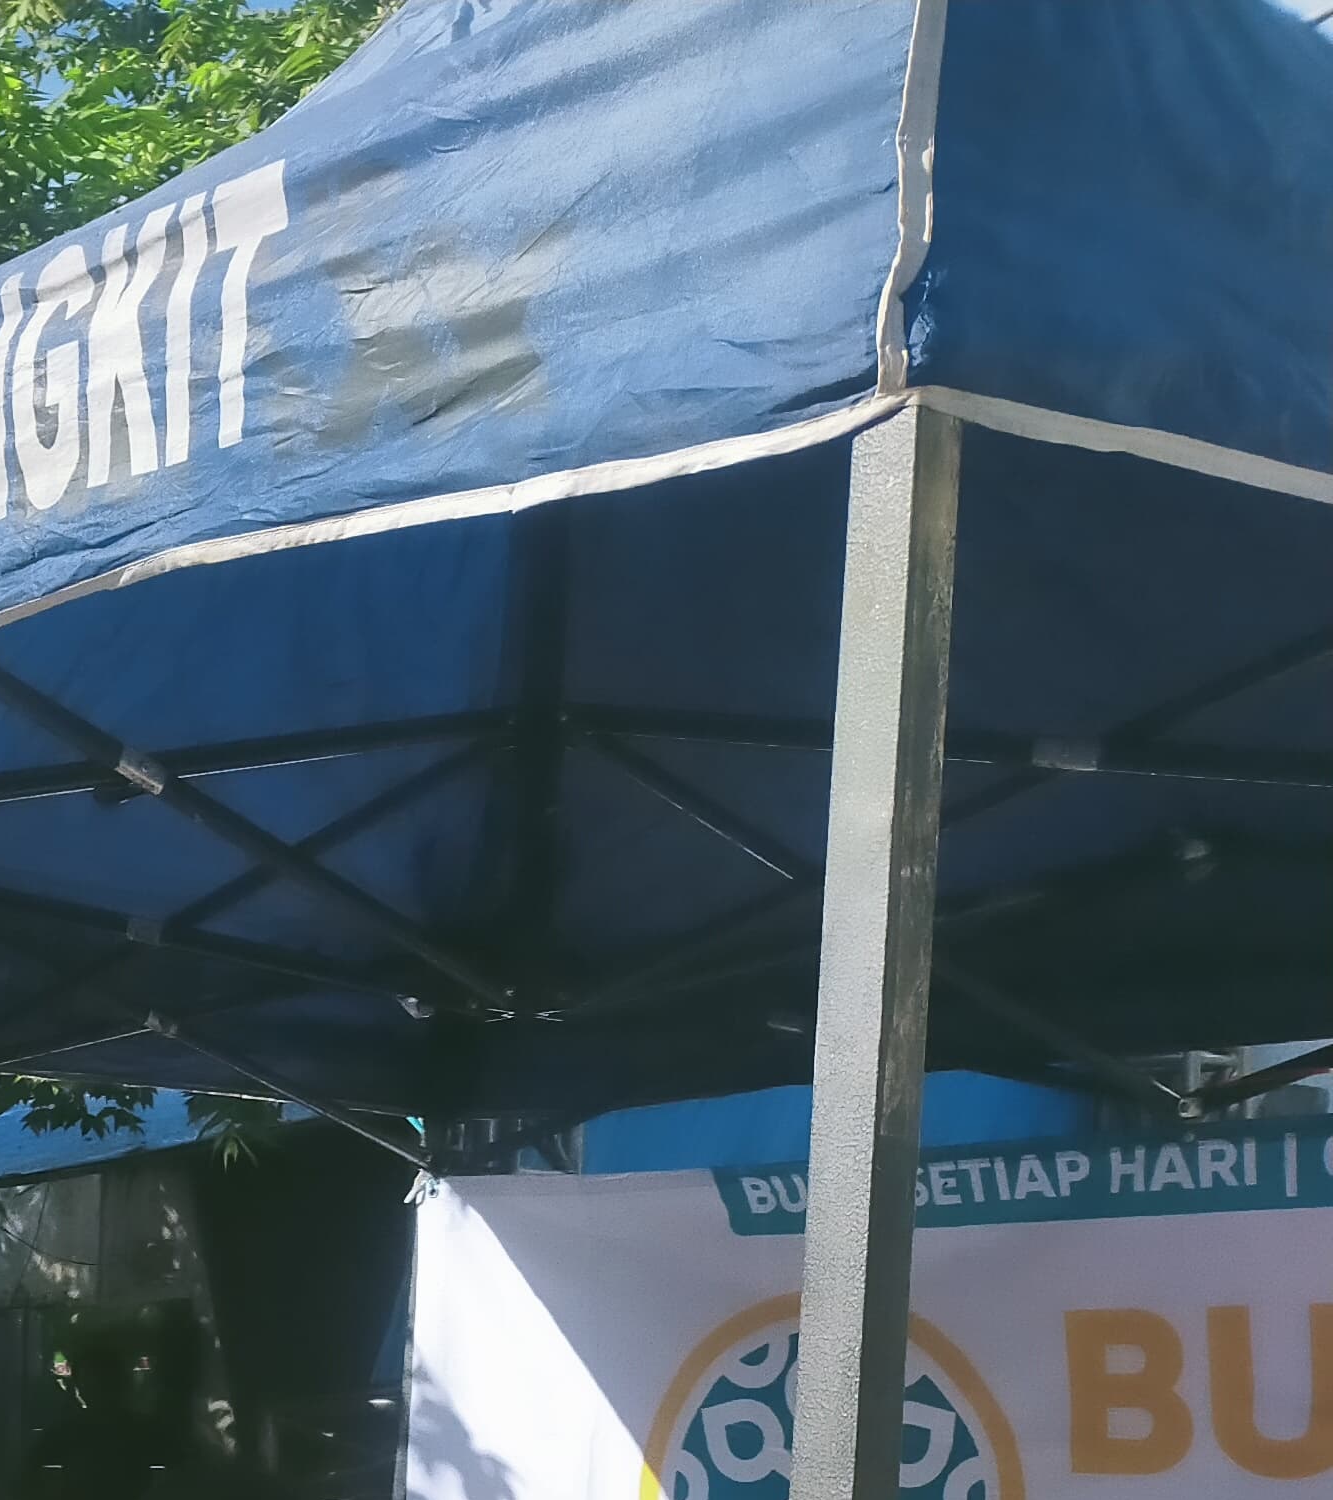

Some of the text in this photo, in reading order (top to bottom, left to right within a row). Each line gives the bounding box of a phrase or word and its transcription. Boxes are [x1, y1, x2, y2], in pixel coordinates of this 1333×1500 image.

[741, 1175, 807, 1215] BU
[915, 1150, 1091, 1208] SETIAP
[1109, 1136, 1257, 1196] HARI
